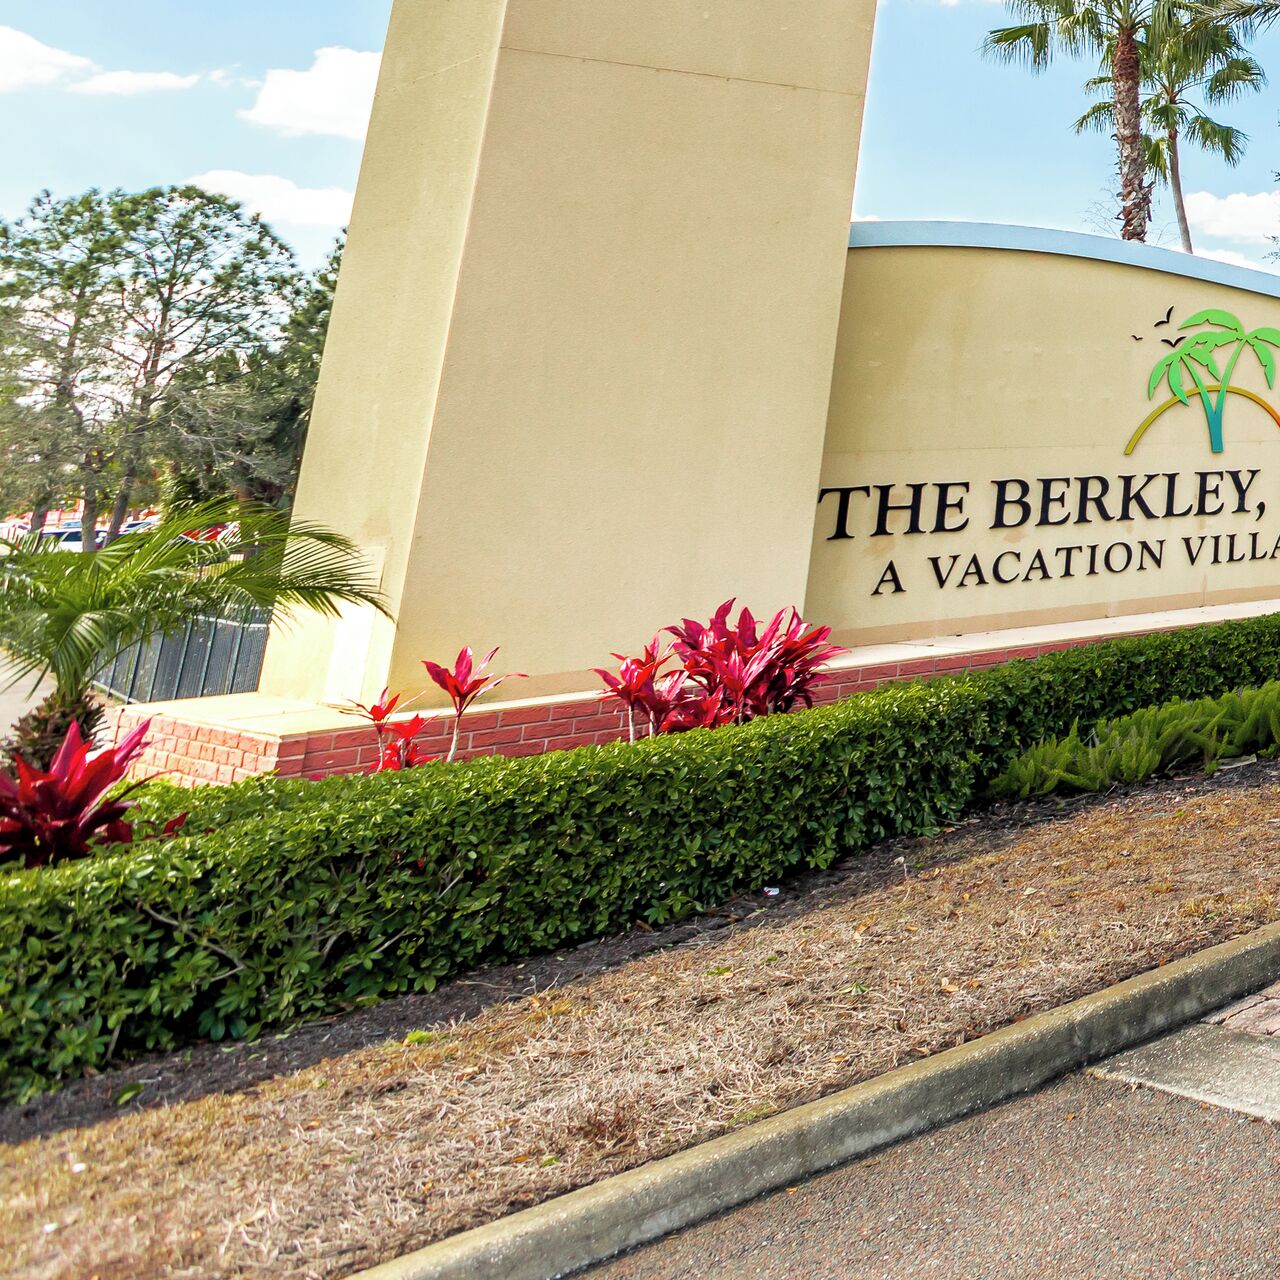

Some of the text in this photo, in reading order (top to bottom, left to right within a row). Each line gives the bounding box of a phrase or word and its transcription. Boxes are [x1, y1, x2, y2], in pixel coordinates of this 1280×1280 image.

[816, 479, 970, 541] THE
[988, 467, 1266, 530] BERKLEY,
[871, 559, 906, 597] A
[928, 537, 1166, 590] VACATION
